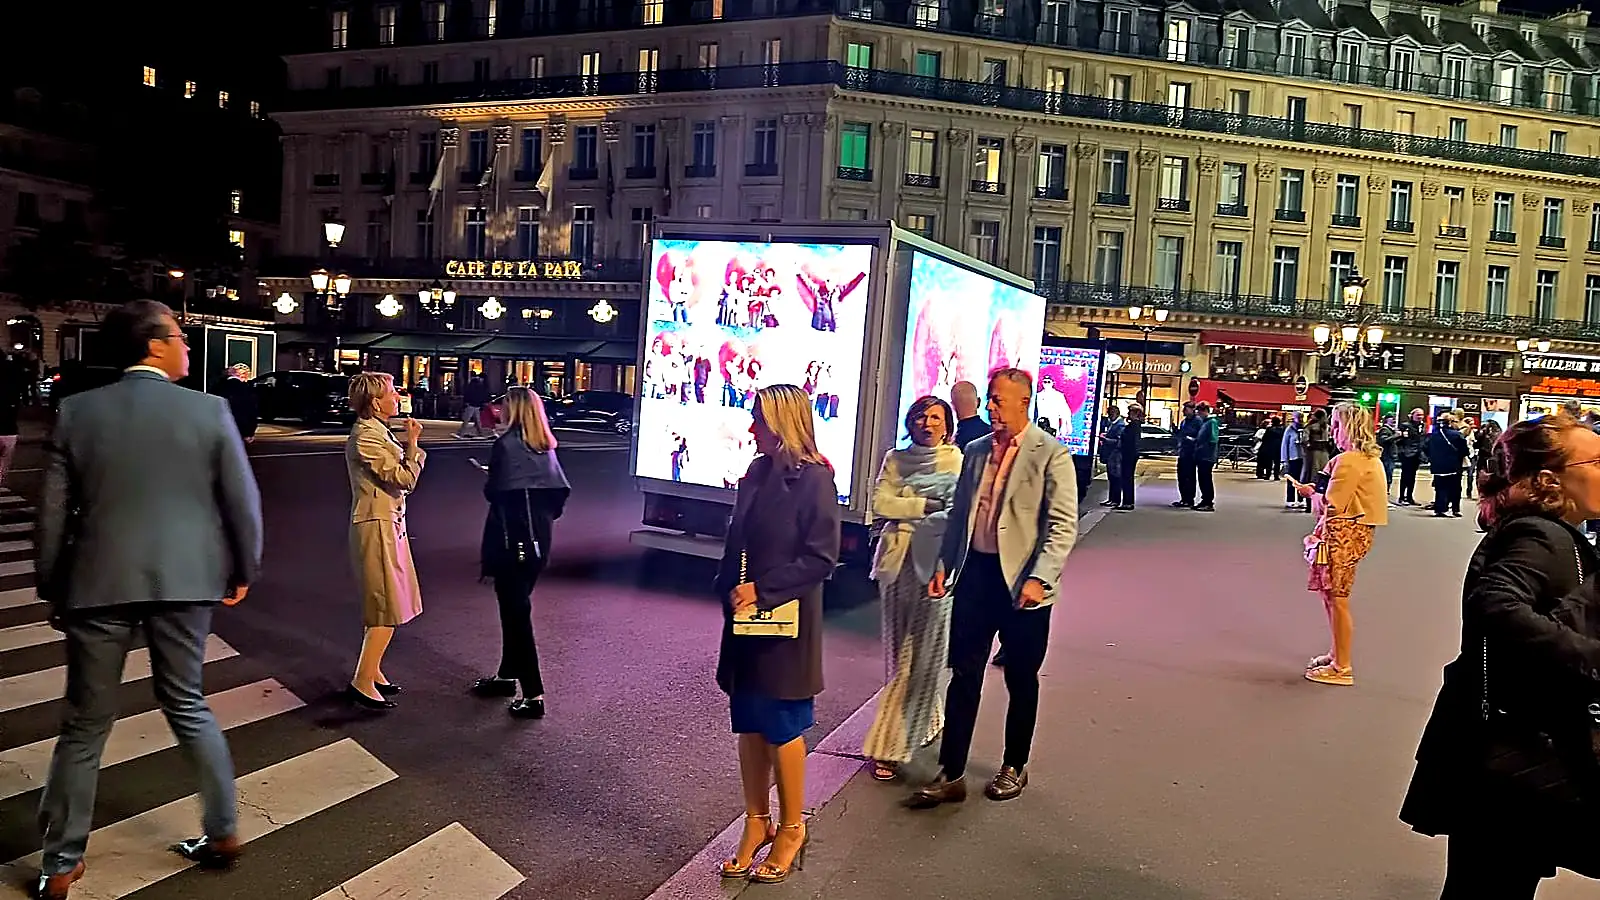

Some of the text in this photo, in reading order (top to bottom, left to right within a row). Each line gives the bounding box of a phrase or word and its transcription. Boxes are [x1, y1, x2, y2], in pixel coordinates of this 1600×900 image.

[491, 260, 512, 275] DE
[518, 260, 538, 275] LA
[544, 261, 581, 277] PAIX
